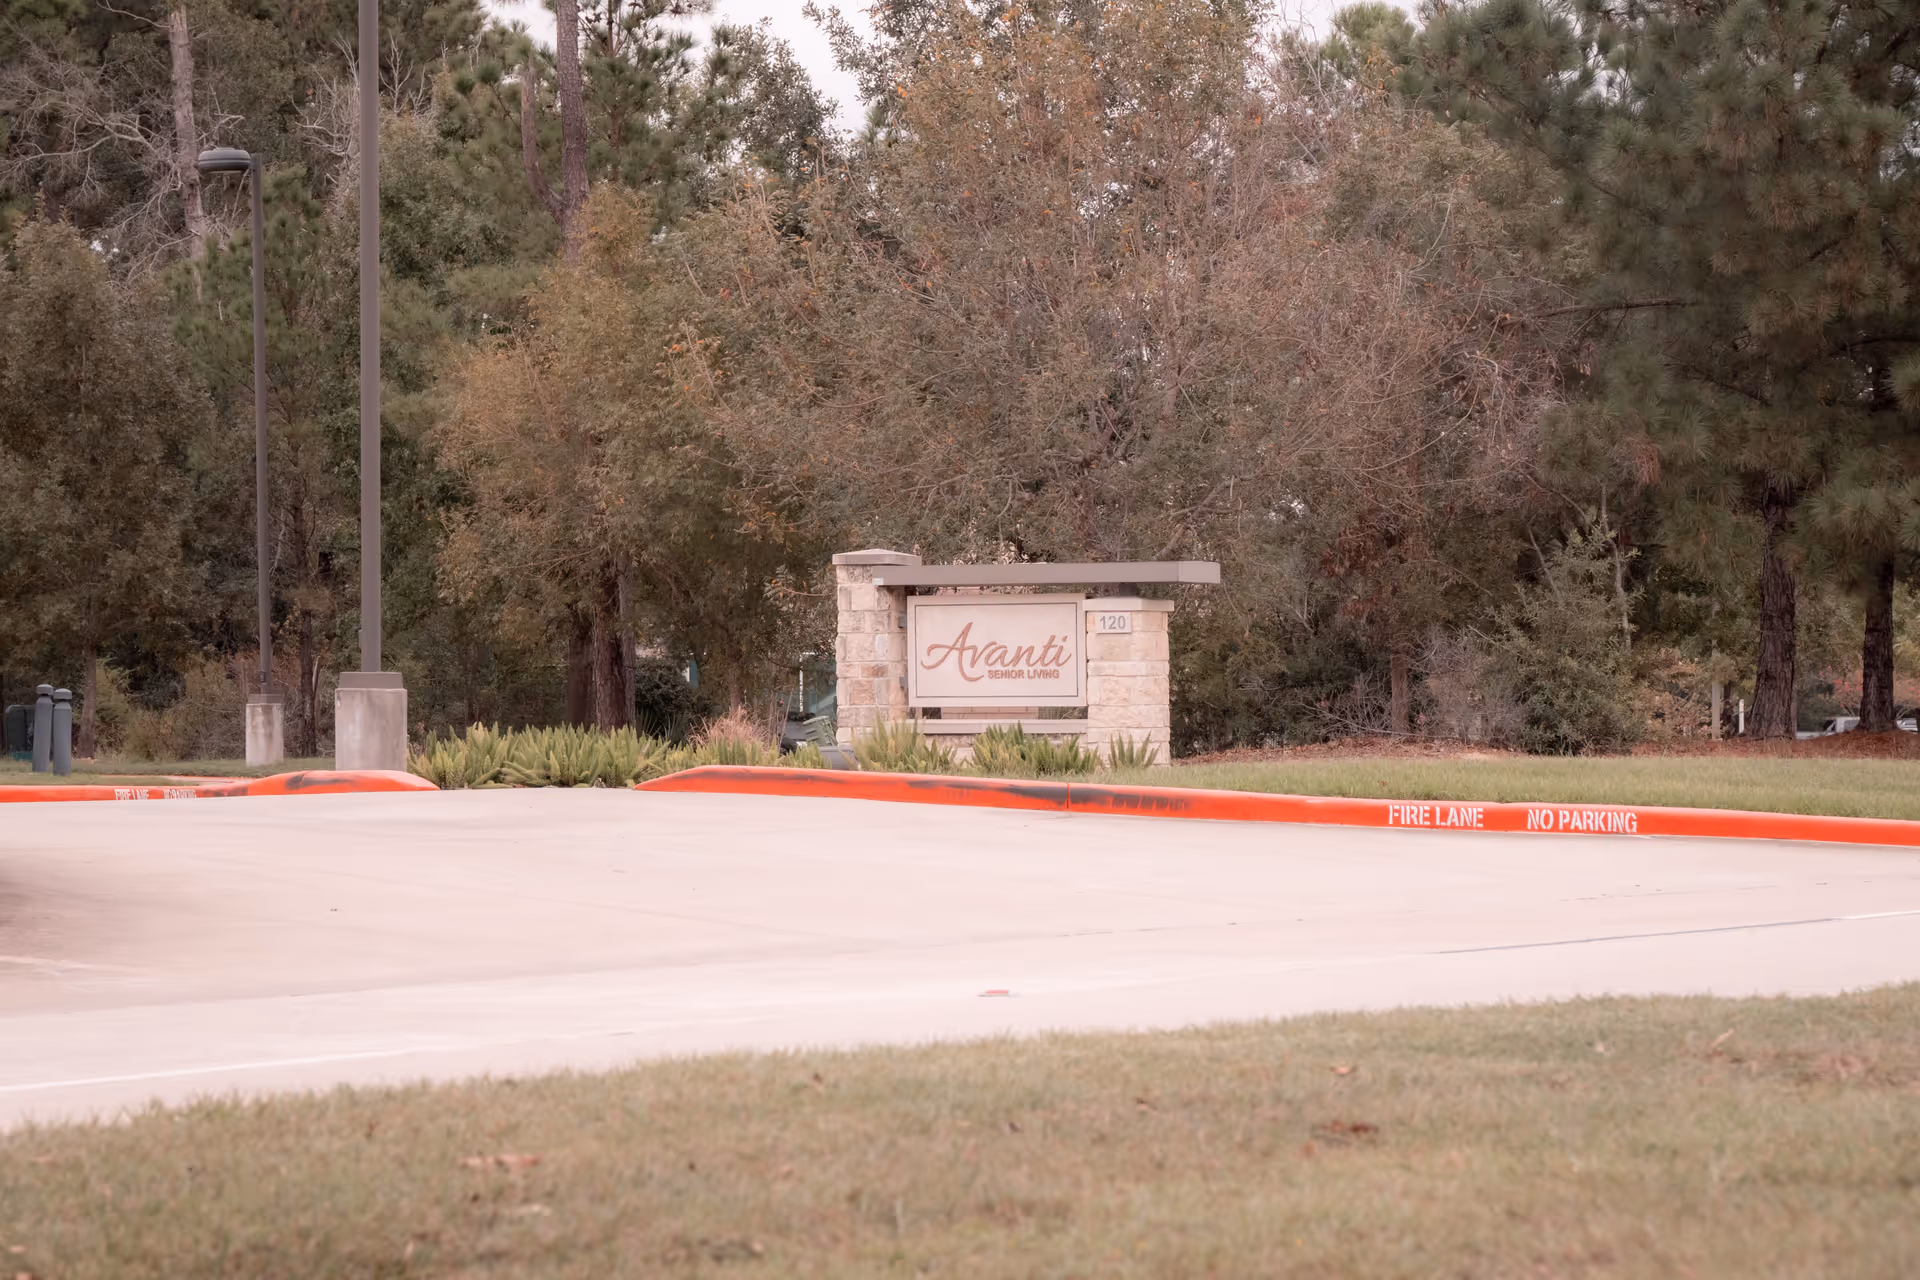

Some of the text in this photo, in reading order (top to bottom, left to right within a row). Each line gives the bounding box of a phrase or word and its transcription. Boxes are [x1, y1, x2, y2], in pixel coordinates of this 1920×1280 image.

[1100, 615, 1126, 630] 120
[920, 621, 1072, 682] Avanti
[987, 669, 1060, 680] SENIOR LIVING
[1388, 805, 1484, 828] FIRE LANE
[1526, 809, 1638, 834] NO PARKING
